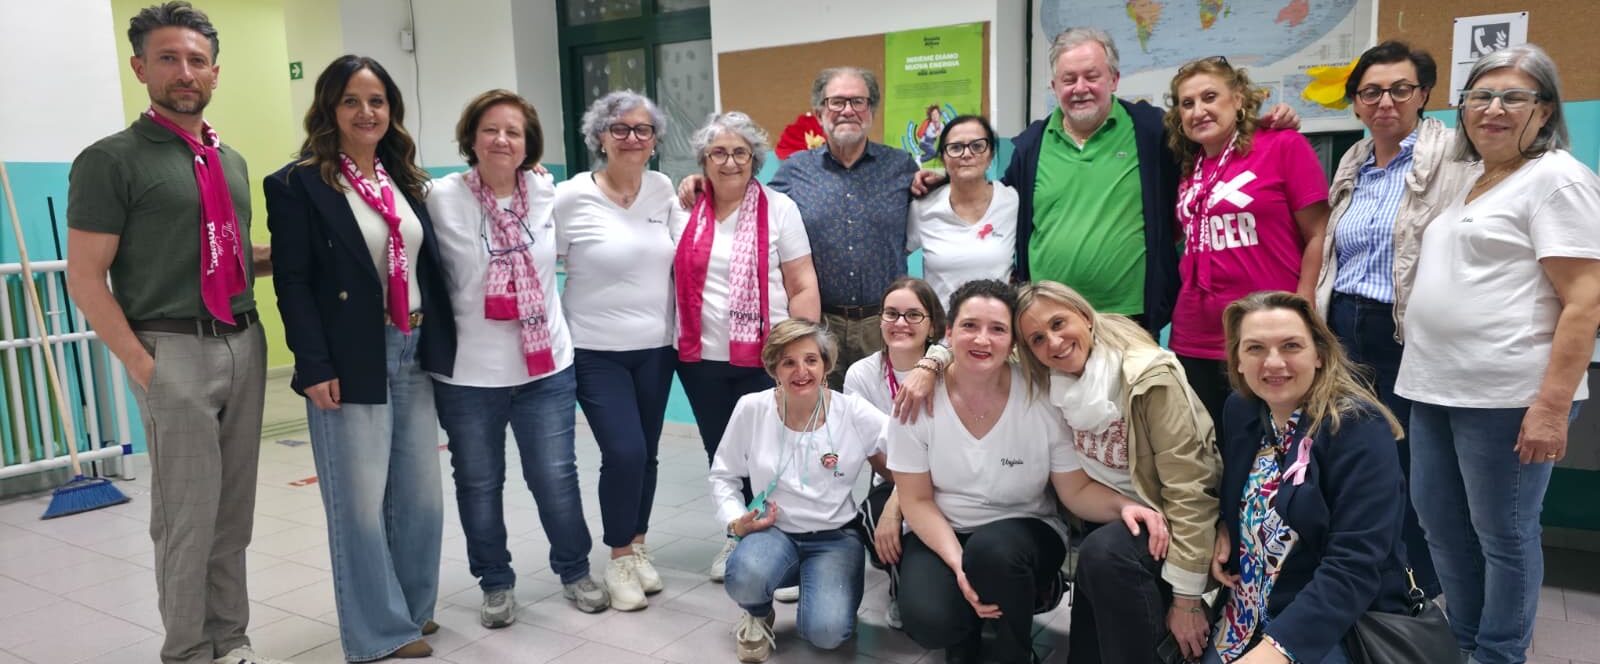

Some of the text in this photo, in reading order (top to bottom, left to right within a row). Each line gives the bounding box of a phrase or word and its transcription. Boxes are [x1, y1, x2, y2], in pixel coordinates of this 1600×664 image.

[906, 52, 959, 63] INSIEME DIAMO
[905, 60, 960, 71] NUOVA ENERGIA
[1210, 211, 1258, 250] CER
